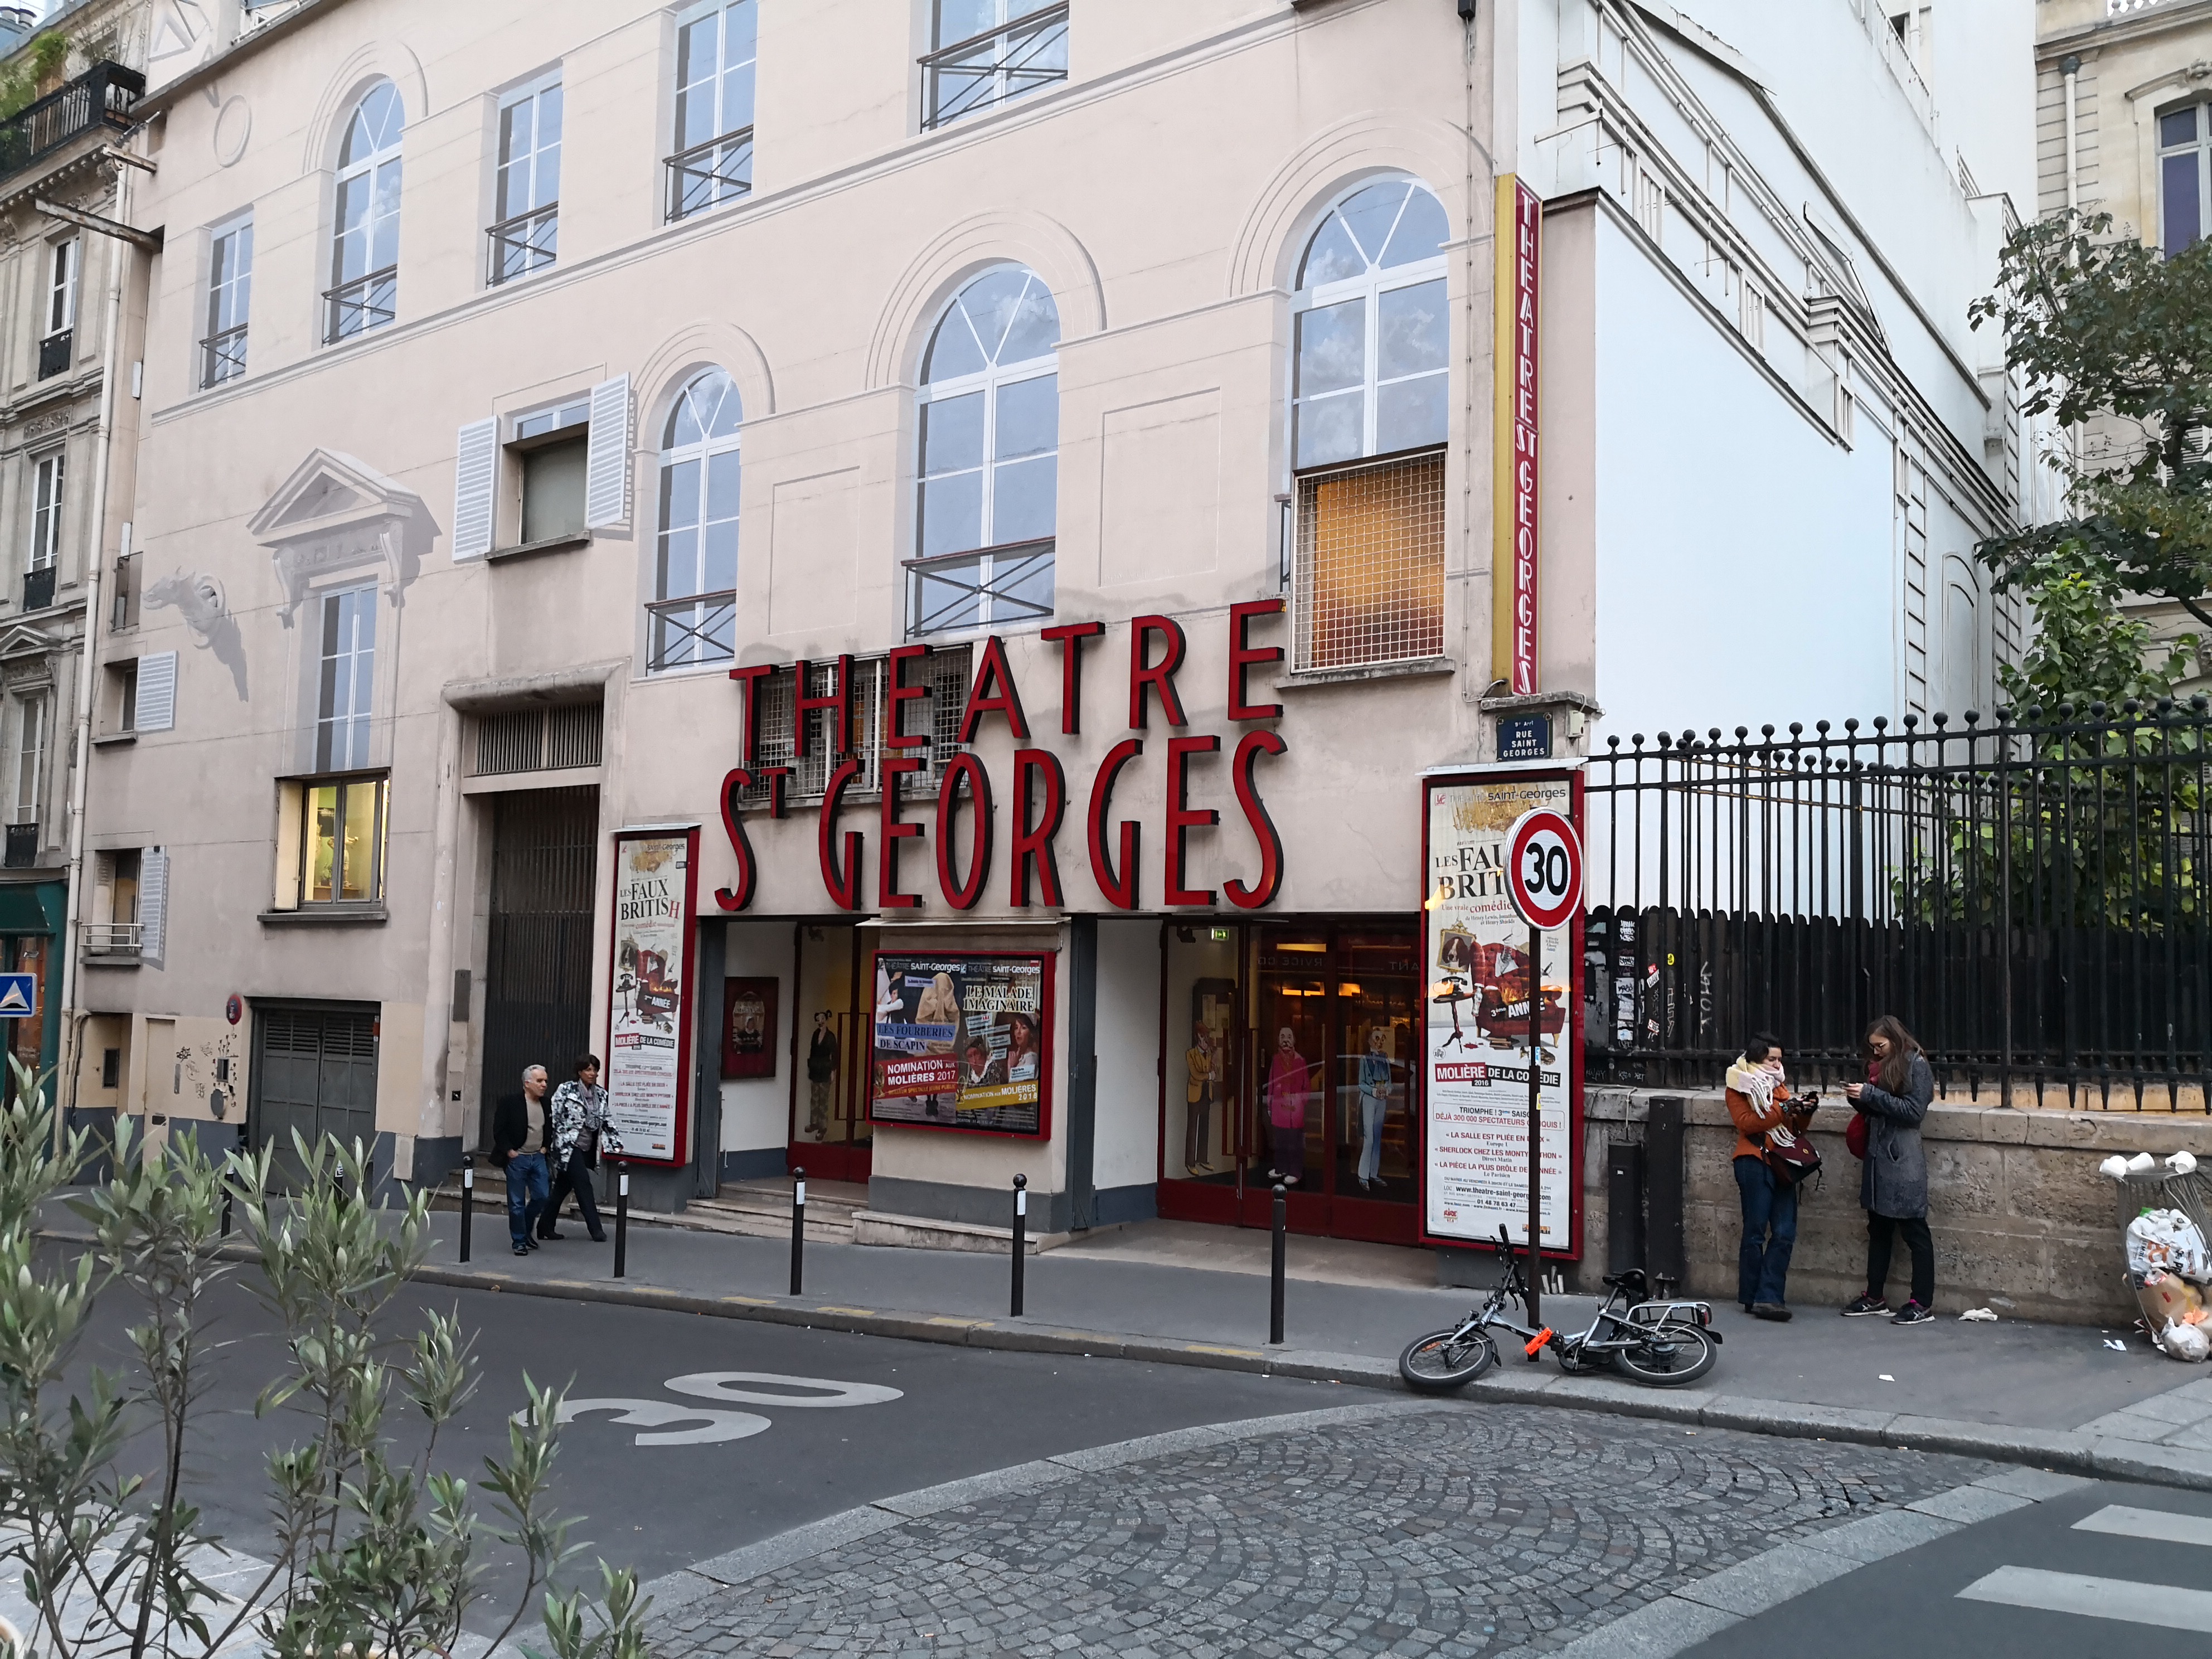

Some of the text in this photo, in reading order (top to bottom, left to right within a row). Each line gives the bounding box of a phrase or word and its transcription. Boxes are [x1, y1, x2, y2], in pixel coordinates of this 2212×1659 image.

[1520, 191, 1534, 425] THEATRE
[1519, 460, 1534, 694] GEORGES
[729, 598, 1286, 763] THEATRE
[1511, 739, 1537, 748] SAINT
[1503, 748, 1545, 758] GEORGES
[818, 730, 1288, 911] GEORGES
[1435, 843, 1504, 872] LES FAU
[1525, 842, 1568, 896] 30
[620, 879, 668, 900] LES FAUX
[1437, 871, 1505, 901] BRIT
[621, 898, 681, 920] BRITISH
[967, 986, 1033, 999] LE MALADE
[963, 998, 1035, 1012] IMAGINAIRE
[1508, 997, 1545, 1018] ANNE
[615, 1034, 639, 1046] MOLIÈRE
[878, 1025, 953, 1037] LES FOURBERIES
[880, 1039, 925, 1050] DE SCAPIN
[887, 1059, 943, 1075] NOMINATION
[1437, 1064, 1558, 1085] MOLIÈRE DE LA COÉDIE
[888, 1070, 955, 1086] MOLIÈRES 2017
[964, 1092, 994, 1100] NOMINATION
[1435, 1112, 1452, 1120] DÉJÀ
[1479, 1117, 1525, 1126] SPECTATEURS
[1459, 1107, 1493, 1115] TRIOMPHE
[515, 1371, 904, 1445] 30
